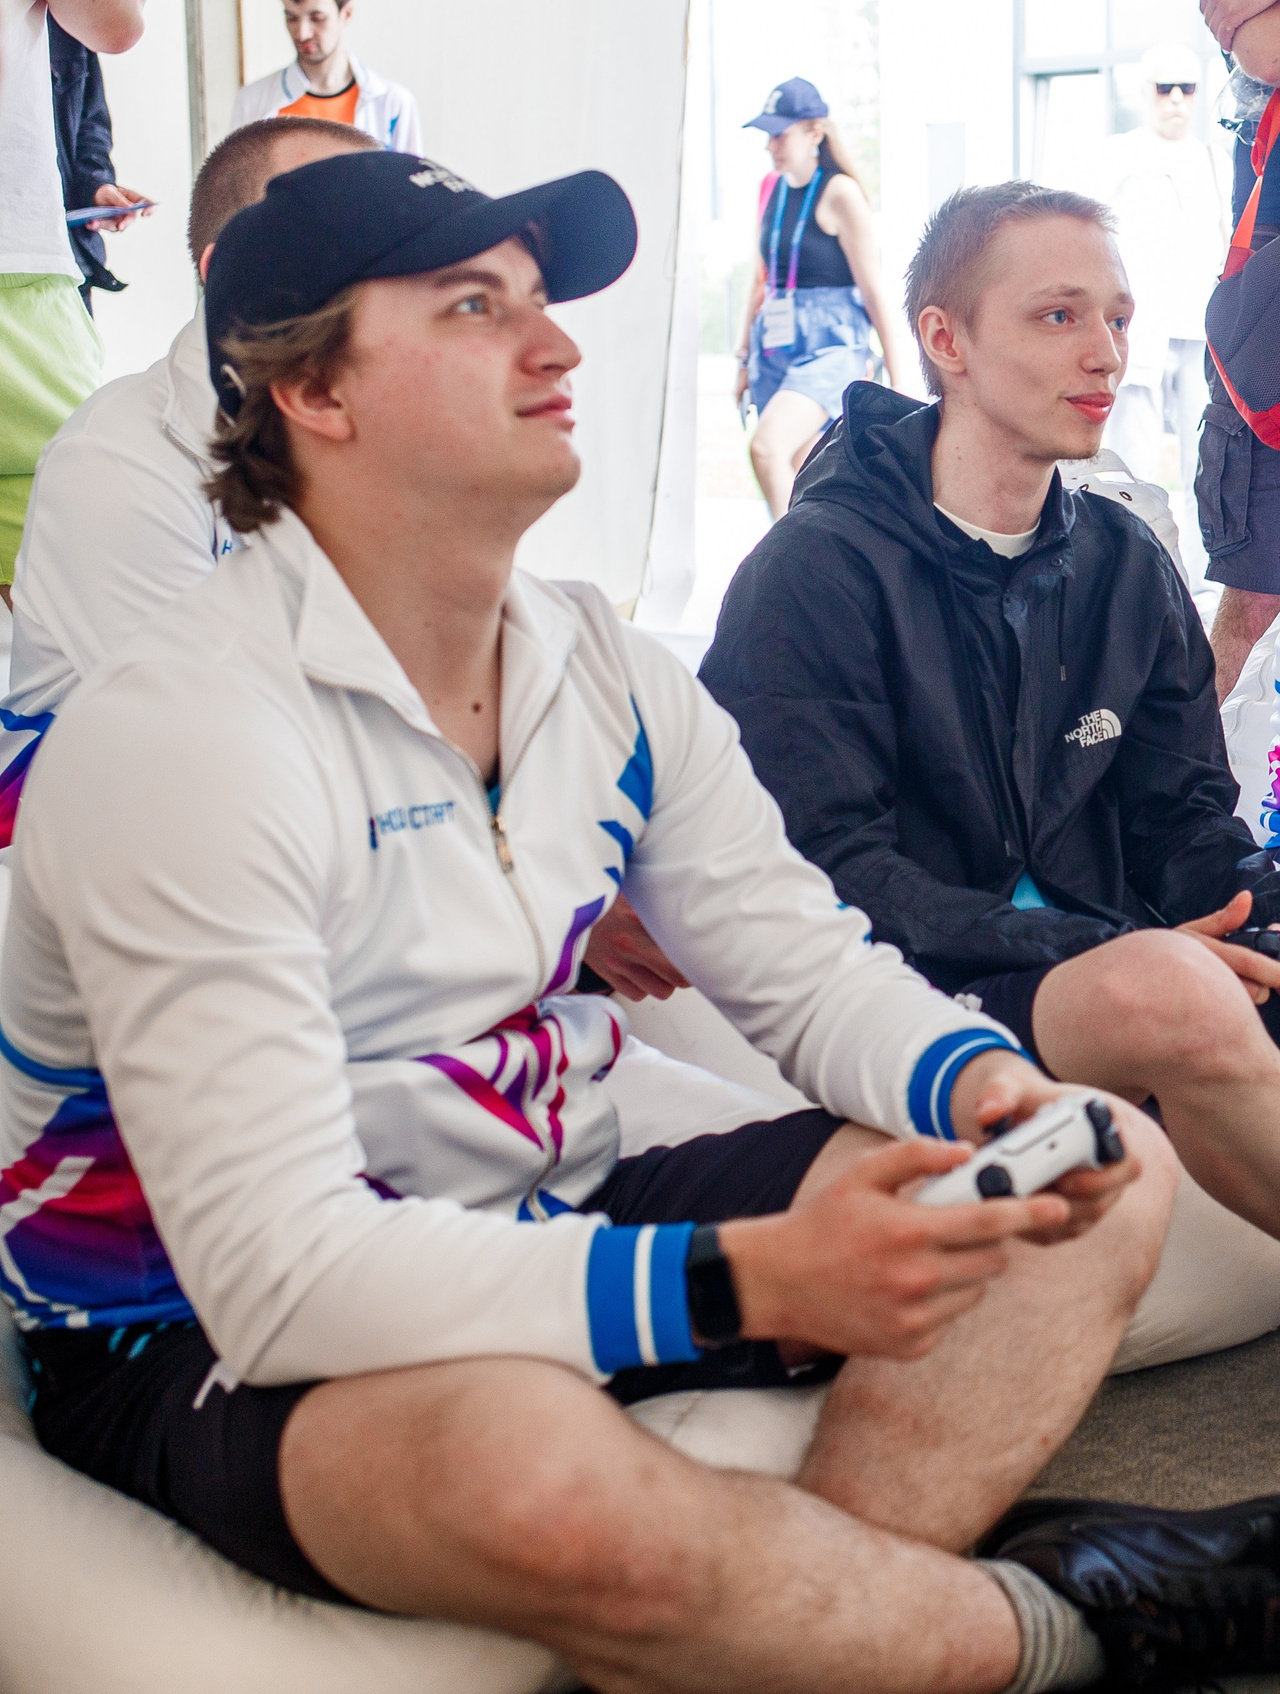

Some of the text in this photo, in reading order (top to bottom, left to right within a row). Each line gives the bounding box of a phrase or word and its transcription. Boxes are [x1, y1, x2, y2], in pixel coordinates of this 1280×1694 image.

[1078, 710, 1101, 726] THE
[1064, 720, 1102, 743] NORTH
[1079, 731, 1104, 748] FACE
